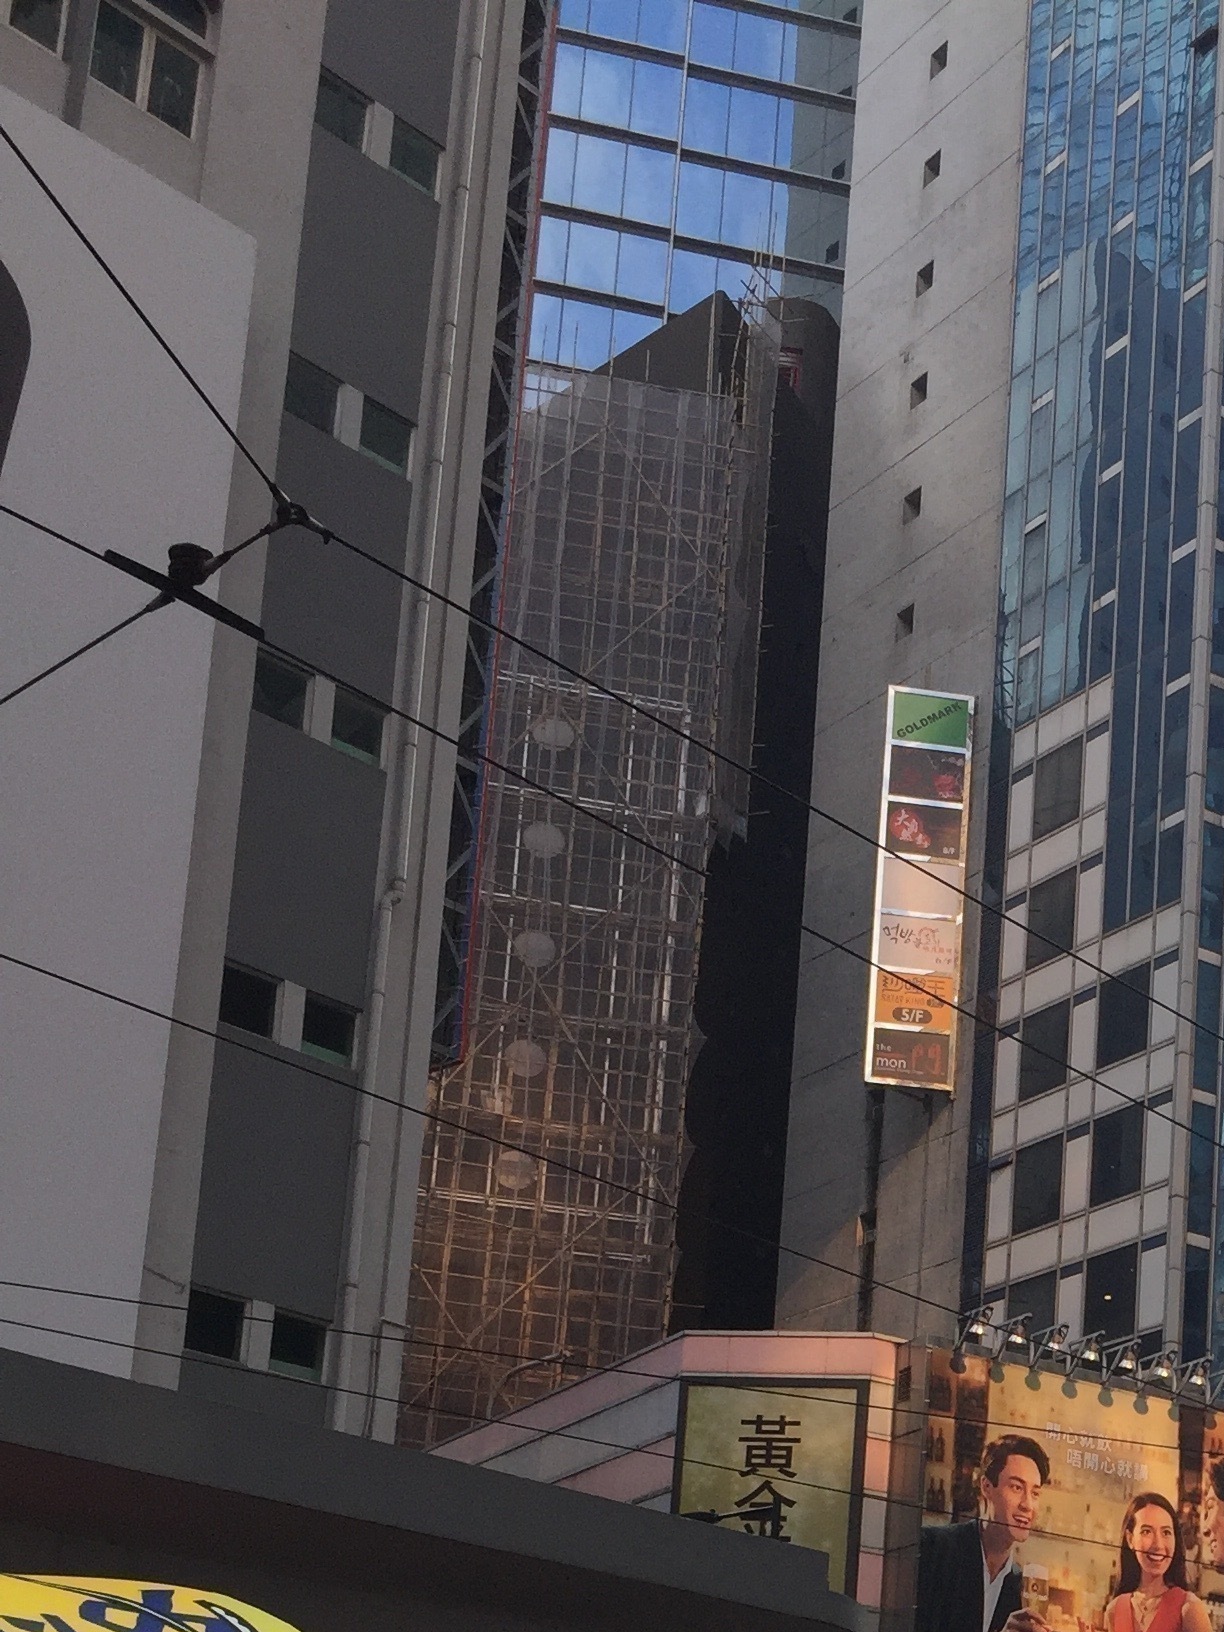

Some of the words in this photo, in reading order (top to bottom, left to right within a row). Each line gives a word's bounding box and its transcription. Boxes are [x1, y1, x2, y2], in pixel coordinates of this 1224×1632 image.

[896, 700, 963, 739] GOLDMARK
[900, 1008, 924, 1023] 5/F
[876, 1057, 907, 1069] mon
